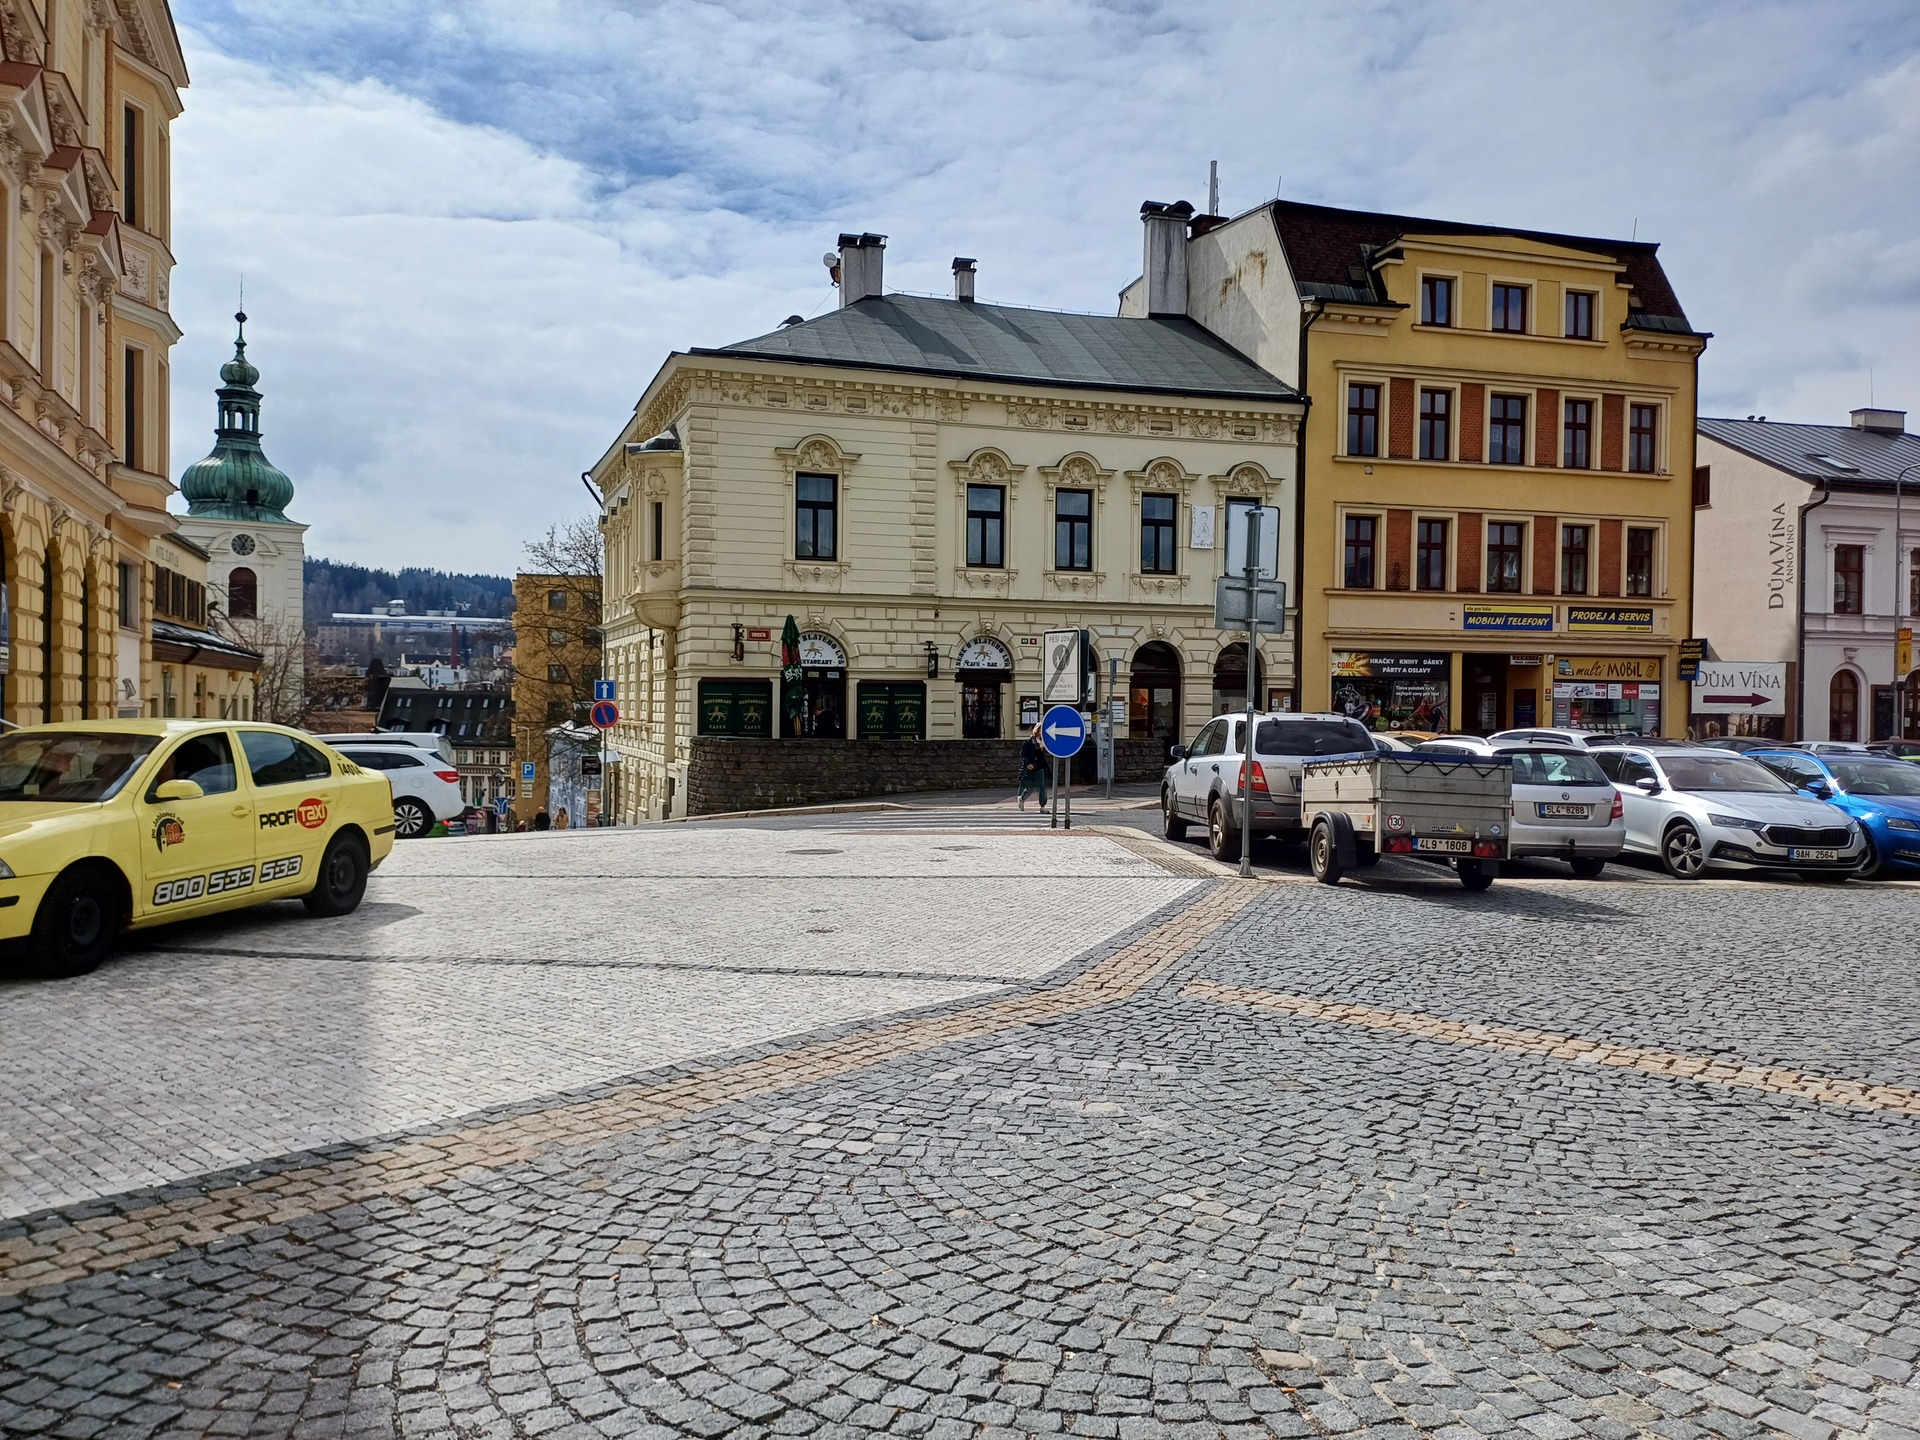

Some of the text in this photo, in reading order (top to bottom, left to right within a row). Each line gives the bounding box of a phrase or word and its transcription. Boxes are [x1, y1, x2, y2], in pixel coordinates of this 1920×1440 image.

[1767, 502, 1785, 609] DŮM VÍNA
[1786, 524, 1794, 584] ANNOVINO
[1467, 615, 1550, 627] MOBILNÍ TELEFONY
[1570, 611, 1607, 621] PRODEJ
[1617, 613, 1650, 622] SERVIS
[1423, 658, 1444, 666] DÁRKY
[1576, 661, 1606, 676] multi
[1694, 670, 1781, 689] DŮM VÍNA
[1546, 805, 1585, 814] 5L4 8288
[259, 809, 297, 830] PROFI
[1390, 817, 1403, 827] 130
[1420, 840, 1468, 850] 4L9 1808
[1796, 850, 1834, 859] 9AH 2564
[153, 855, 303, 905] 800 533 533
